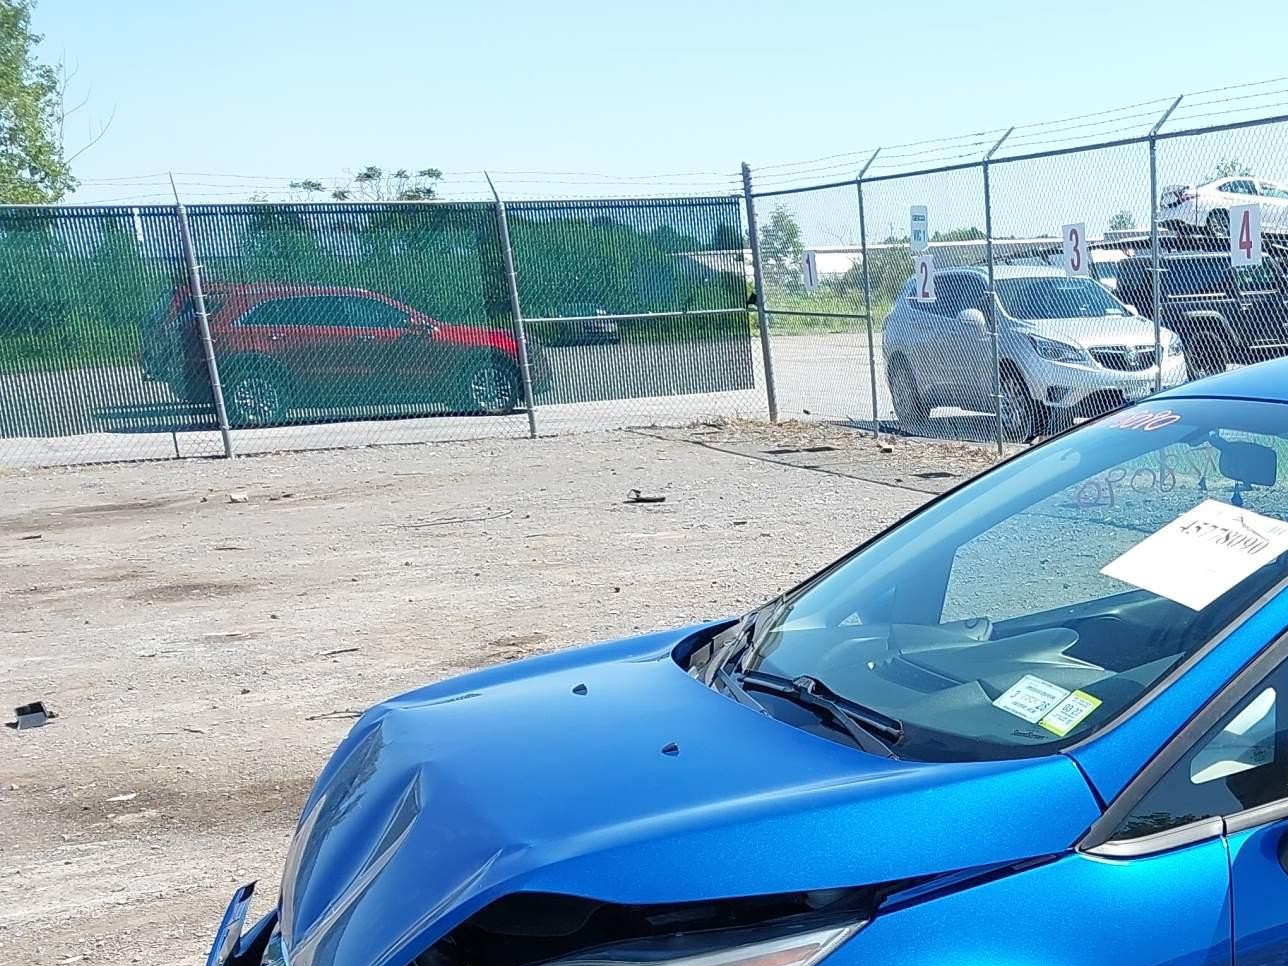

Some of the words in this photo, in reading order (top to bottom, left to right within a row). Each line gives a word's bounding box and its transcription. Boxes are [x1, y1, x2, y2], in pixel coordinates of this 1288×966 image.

[1069, 228, 1081, 271] 3
[1239, 210, 1253, 259] 4
[805, 254, 814, 287] 1
[920, 261, 930, 298] 2
